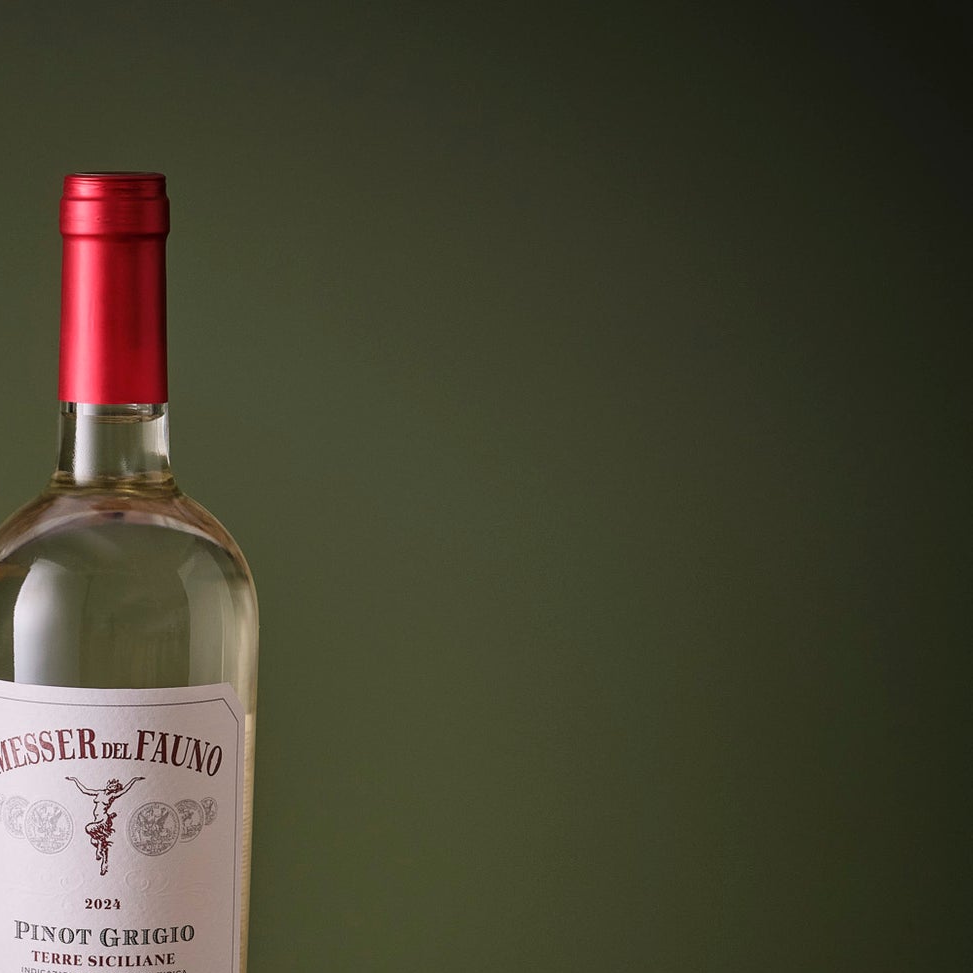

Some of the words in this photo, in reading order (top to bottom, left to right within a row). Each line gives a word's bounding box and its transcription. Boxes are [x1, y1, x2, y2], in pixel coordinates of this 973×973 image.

[101, 742, 132, 760] DEL
[137, 729, 223, 777] FAUNO
[85, 898, 122, 910] 2024
[14, 919, 92, 946] PINOT
[99, 924, 195, 947] GRIGIO
[31, 950, 83, 967] TERRE
[87, 952, 176, 968] SICILIANE
